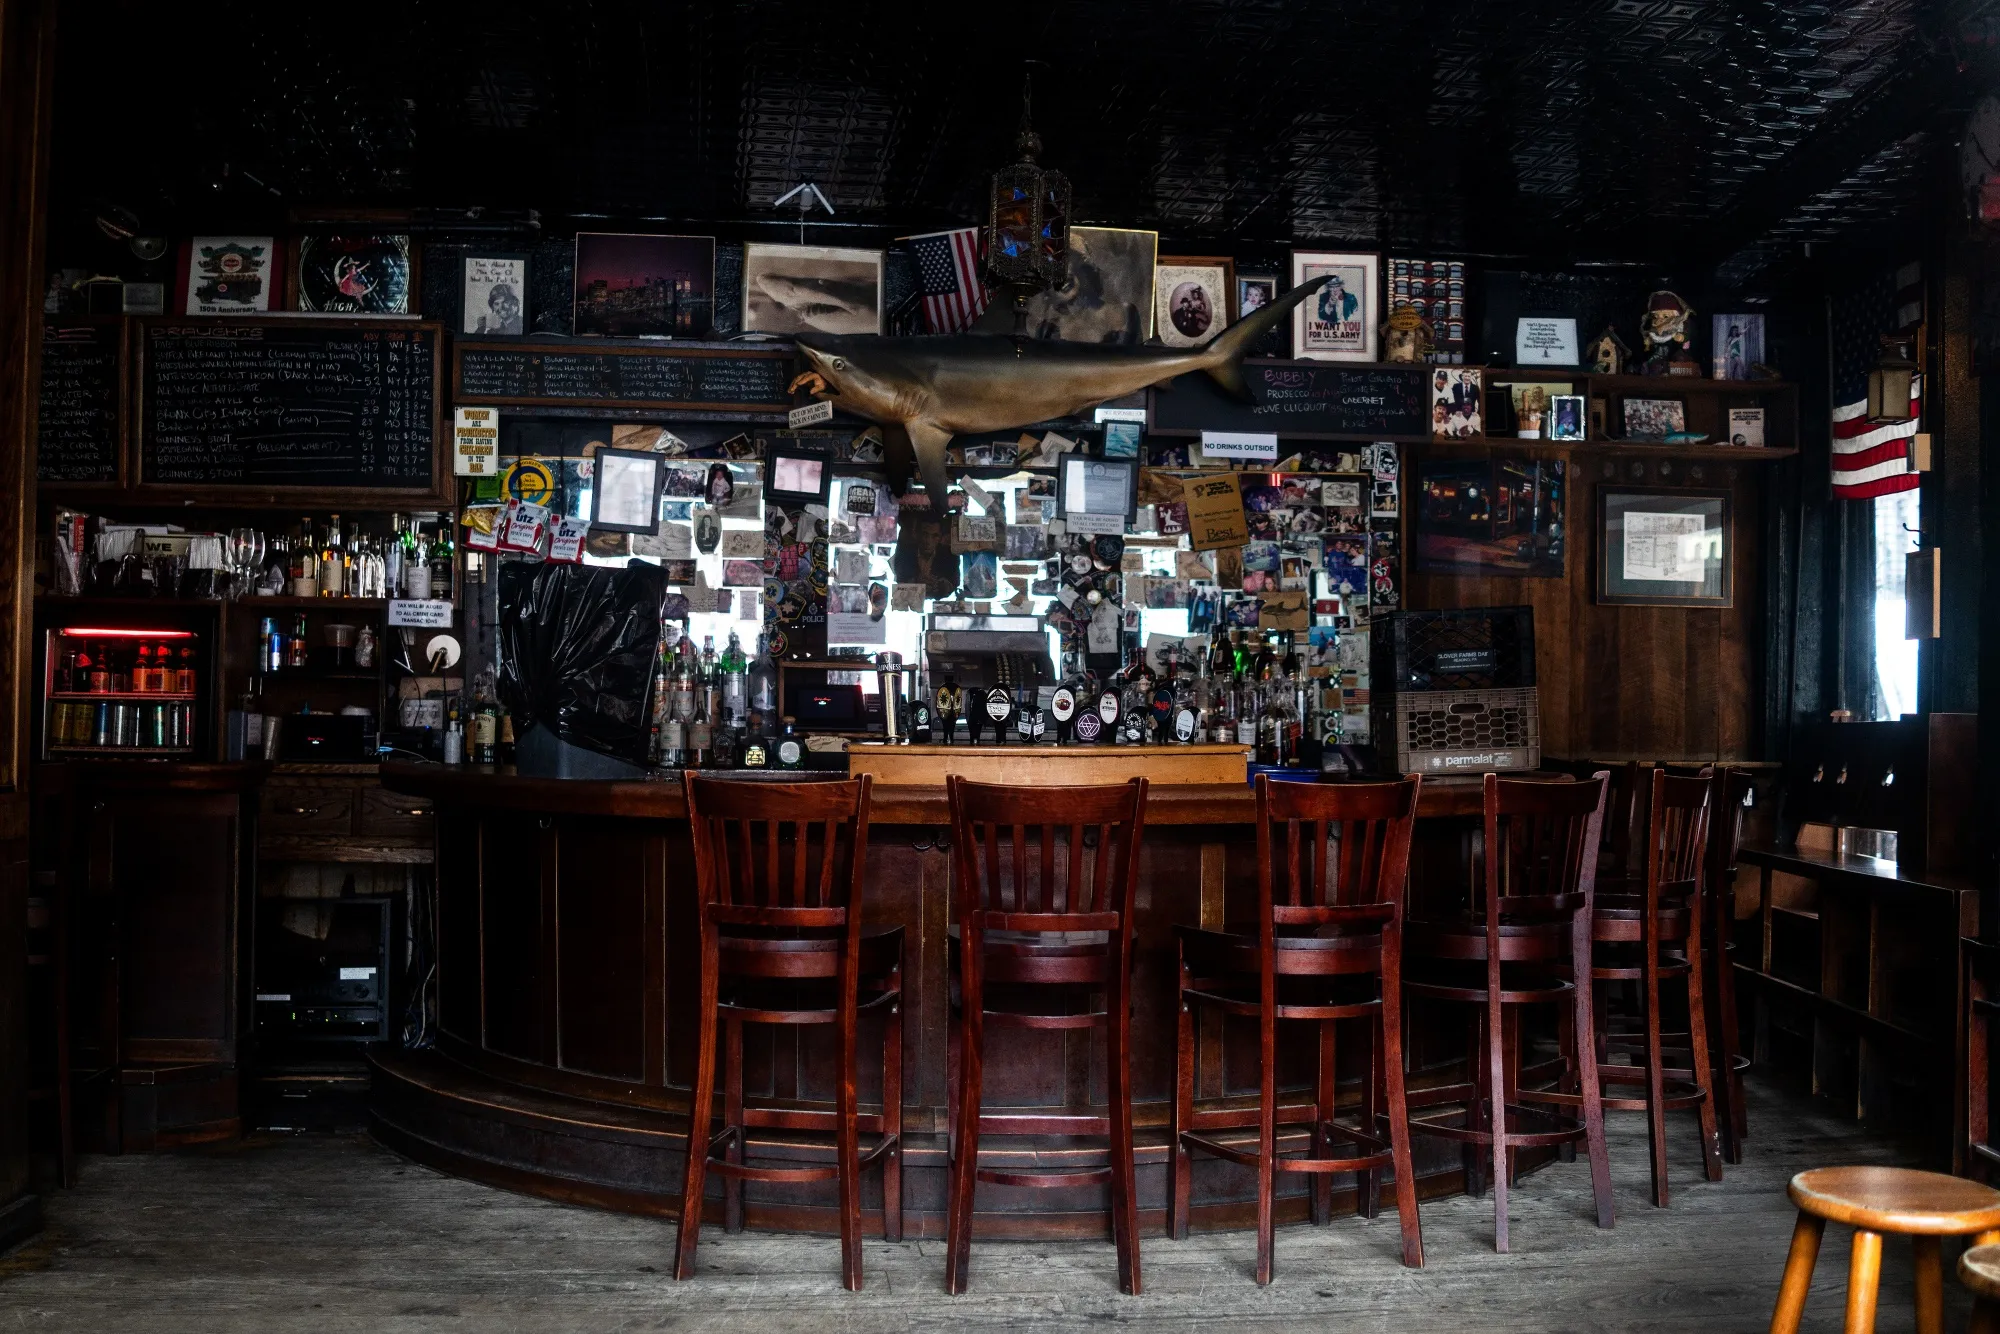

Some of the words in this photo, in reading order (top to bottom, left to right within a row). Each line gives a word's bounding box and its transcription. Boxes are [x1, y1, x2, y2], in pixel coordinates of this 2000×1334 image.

[218, 307, 257, 315] Anniversary
[1308, 321, 1312, 331] I
[1315, 321, 1341, 331] WANT
[1343, 321, 1361, 332] YOU
[150, 327, 264, 338] DRAUGHTS
[1308, 331, 1321, 339] FOR
[1324, 331, 1340, 339] U.S.
[1341, 331, 1361, 339] ARMY
[156, 372, 217, 382] INTERBORO
[220, 371, 247, 380] CAST
[250, 371, 275, 380] IRON
[387, 376, 401, 386] NY
[665, 372, 681, 382] RYE
[1264, 369, 1316, 389] BUBBLY
[1267, 389, 1310, 398] PROSECCO
[1253, 403, 1281, 414] VEUVE
[1283, 402, 1327, 413] CLICQUOT
[464, 410, 490, 420] WOMEN
[471, 420, 482, 428] ARE
[456, 428, 497, 438] PROHIBITED
[156, 434, 202, 444] GUINNESS
[208, 433, 231, 443] STOUT
[460, 438, 475, 446] FROM
[475, 438, 493, 446] HAVING
[387, 442, 401, 452] NY
[459, 446, 494, 456] CHILDREN
[1216, 443, 1243, 451] DRINKS
[1244, 444, 1275, 452] OUTSIDE
[157, 455, 211, 466] BROOKLYN
[388, 455, 401, 464] NY
[469, 463, 483, 473] BAR
[157, 469, 205, 480] GUINNESS
[209, 468, 245, 480] STOUT
[1206, 480, 1227, 488] new
[1209, 484, 1232, 492] york
[848, 487, 875, 497] MEAN
[1207, 488, 1234, 497] press
[848, 496, 875, 504] PEOPLE
[848, 502, 875, 512] SUCK
[515, 514, 535, 525] utz
[558, 529, 577, 538] utz
[1206, 528, 1234, 540] Best
[146, 542, 172, 552] WE
[553, 537, 580, 547] Original
[802, 615, 825, 623] POLICE
[877, 663, 902, 673] GUINNESS
[1445, 753, 1494, 768] parmalat
